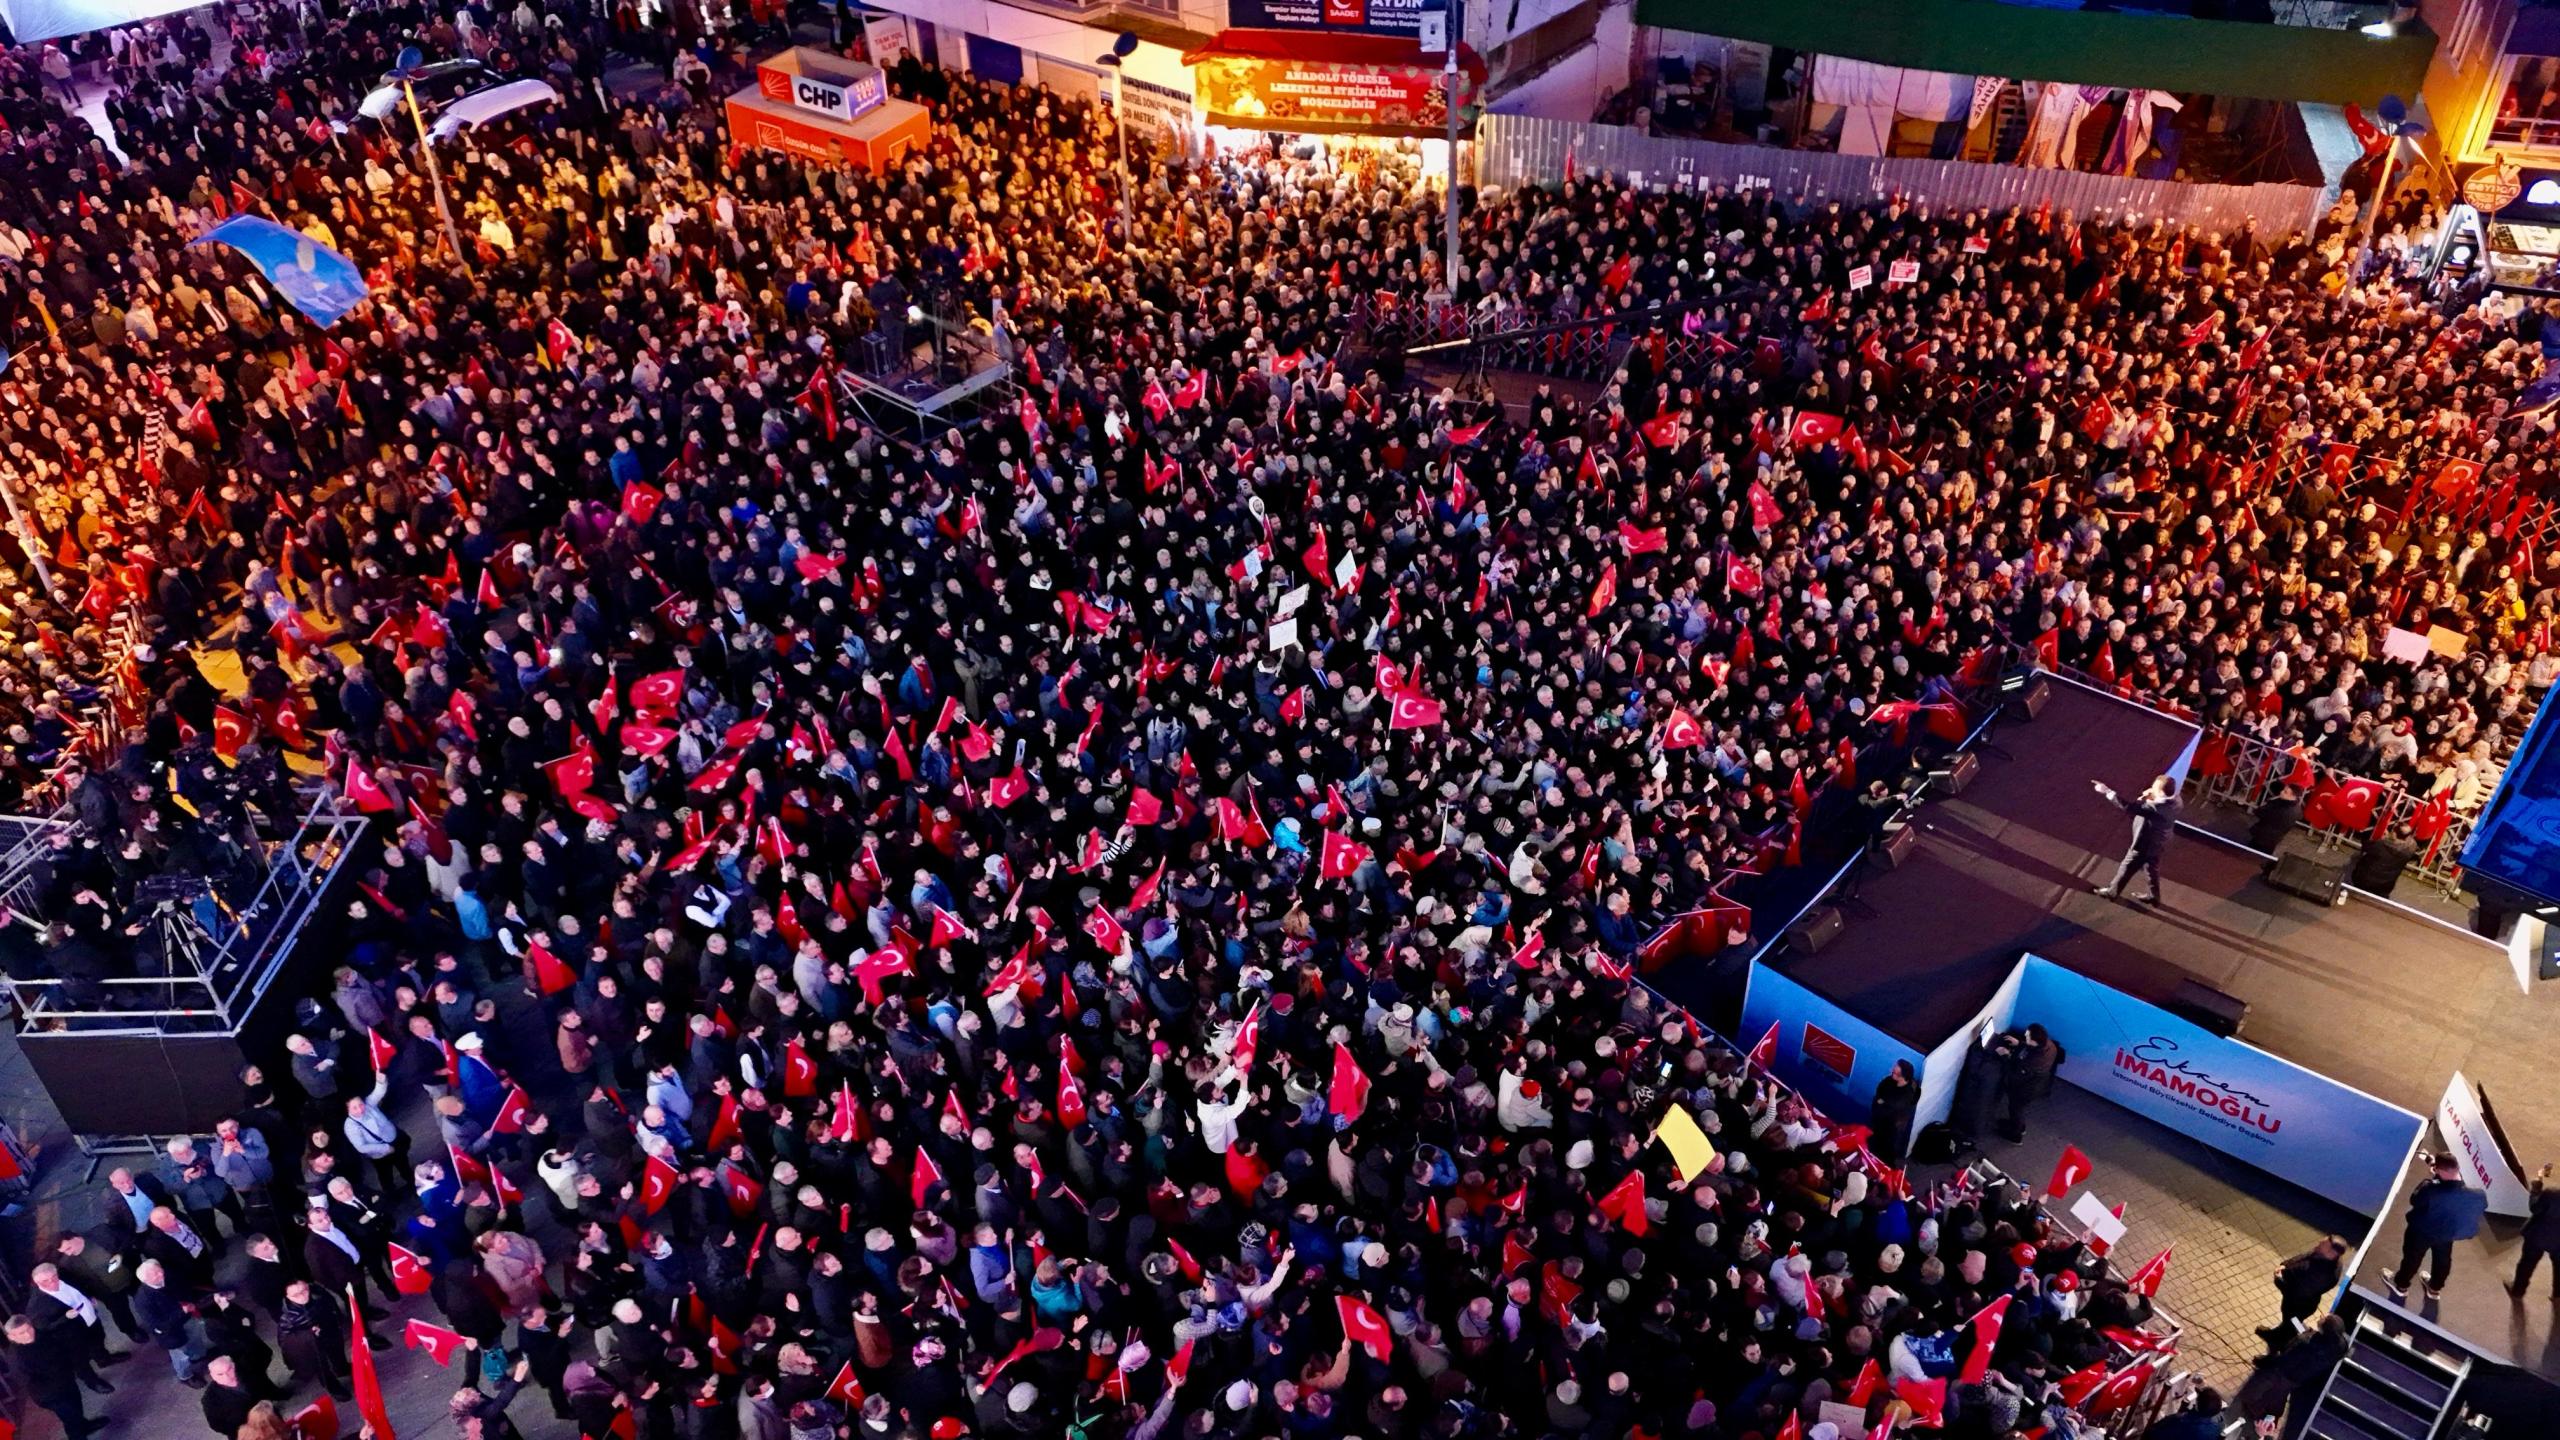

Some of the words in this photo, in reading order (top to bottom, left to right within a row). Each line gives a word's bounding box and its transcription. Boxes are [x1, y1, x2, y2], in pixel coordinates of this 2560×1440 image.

[1329, 9, 1359, 17] SAADET
[798, 83, 841, 110] CHP
[1285, 70, 1340, 82] ANADOLU
[2112, 1069, 2148, 1091] İstanbul
[2149, 1086, 2198, 1112] Büyükşehir
[2198, 1108, 2237, 1130] Belediye
[2114, 1047, 2282, 1134] İMAMOĞLU
[2444, 1098, 2460, 1127] TAM
[2459, 1125, 2472, 1156] YOL
[2471, 1145, 2493, 1190] İLERİ
